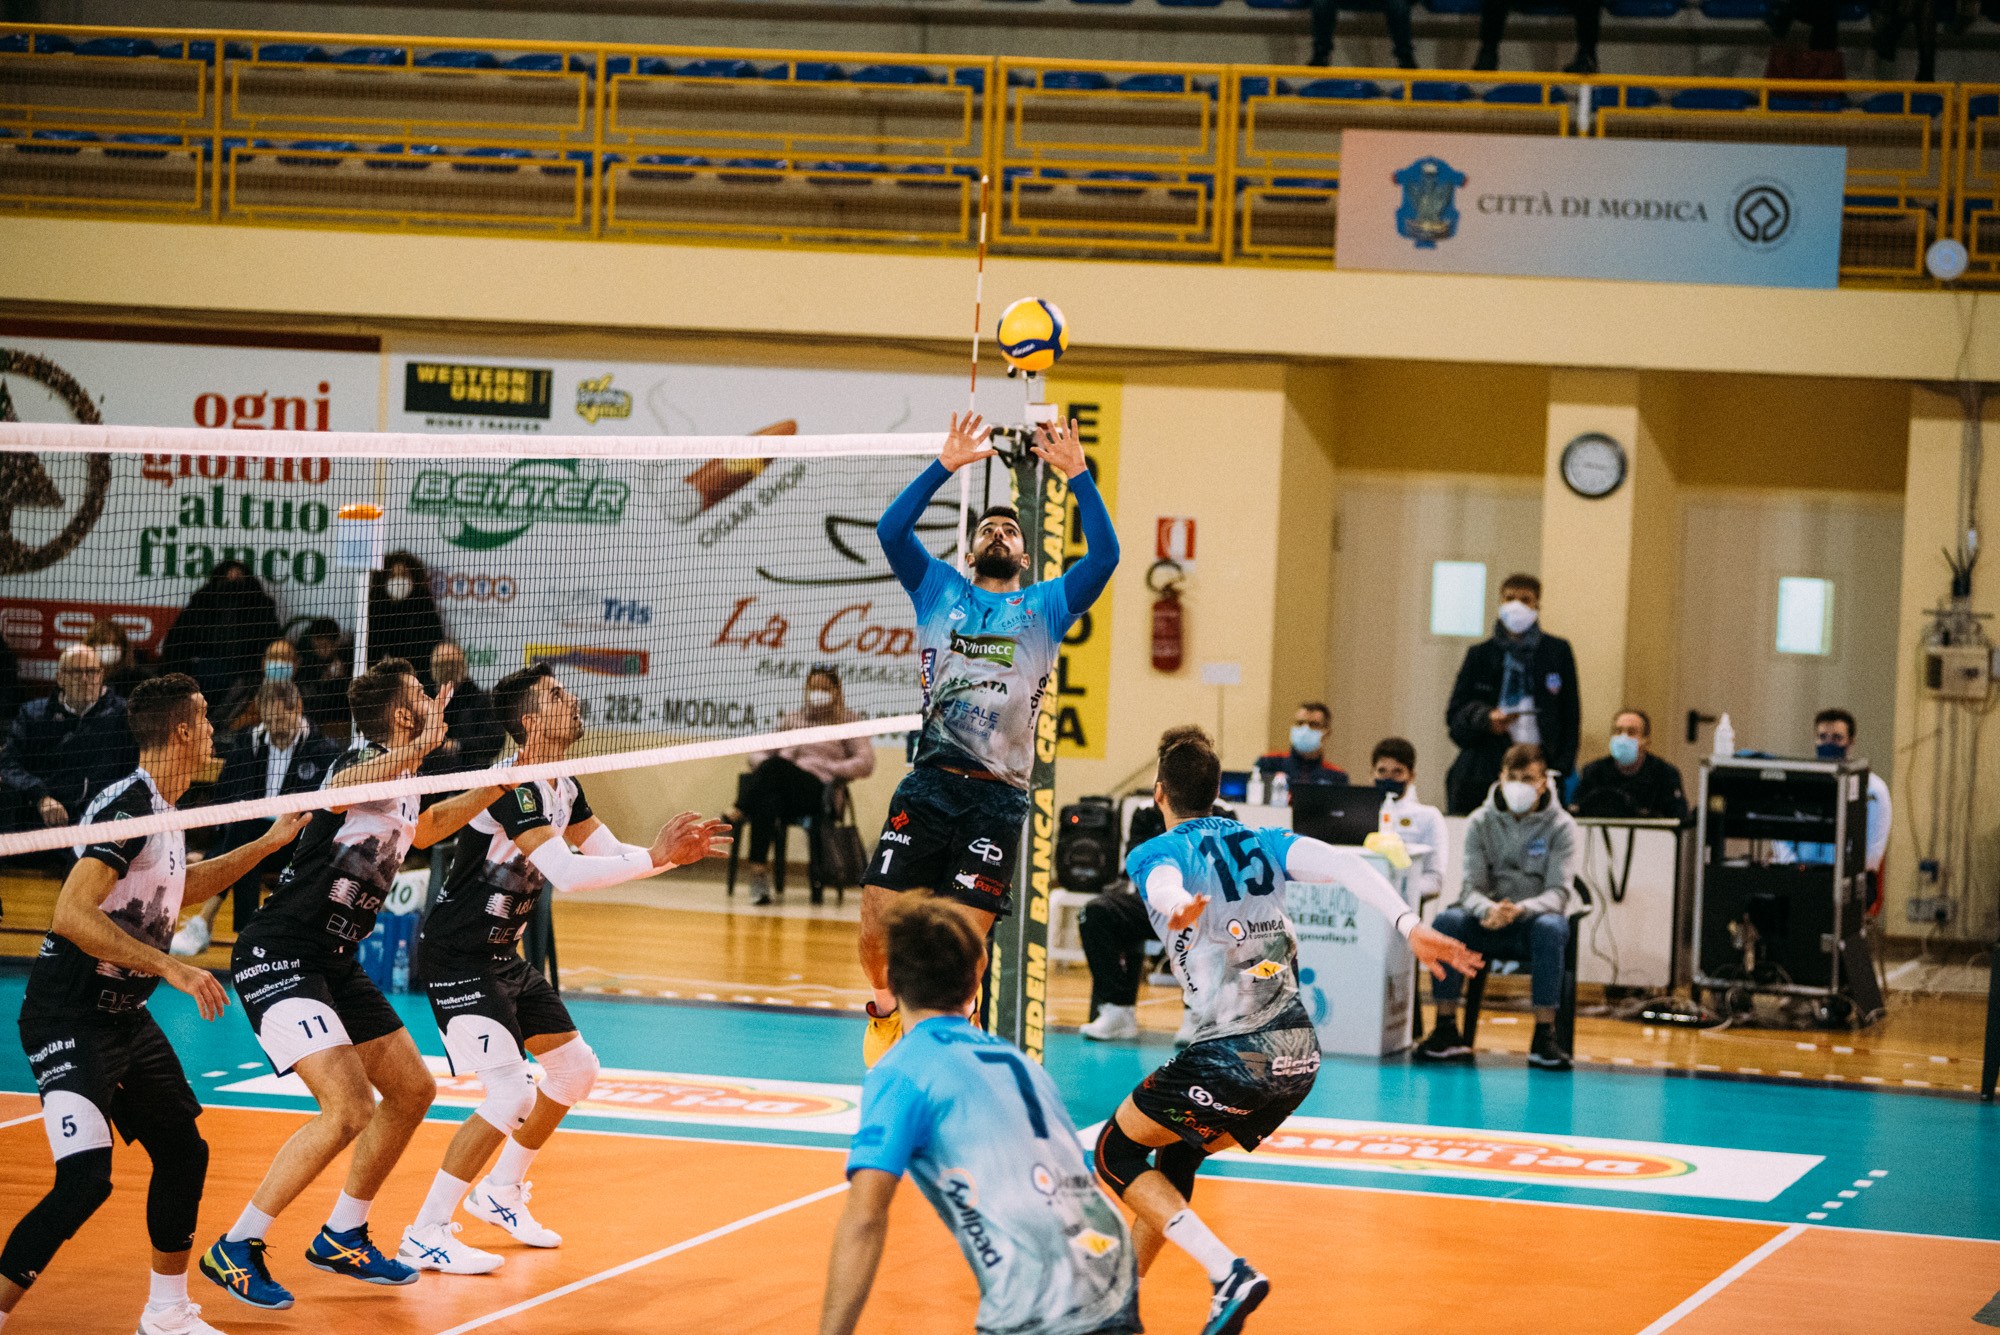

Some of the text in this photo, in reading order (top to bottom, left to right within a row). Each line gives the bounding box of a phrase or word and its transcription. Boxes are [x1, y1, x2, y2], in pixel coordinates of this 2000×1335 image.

[1476, 190, 1709, 223] CITTÀ DI MODICA
[417, 365, 528, 386] WESTERN
[450, 382, 526, 403] UNION
[194, 381, 332, 432] ogni
[179, 484, 329, 535] al tuo
[136, 525, 327, 586] fianco
[603, 598, 650, 625] Tris
[714, 597, 920, 658] La Con
[663, 698, 758, 729] MODICA
[952, 711, 996, 731] UTUA
[955, 699, 1001, 723] REALE
[880, 849, 894, 874] 1
[1030, 788, 1054, 925] BANCA
[1198, 829, 1276, 903] 15
[1343, 916, 1357, 929] A
[271, 960, 290, 971] CAR
[290, 959, 301, 969] srl
[1024, 942, 1047, 1066] REDEM
[298, 1015, 329, 1039] 11
[64, 1038, 76, 1050] srl
[478, 1034, 490, 1054] 7
[973, 1051, 1050, 1140] 7
[61, 1114, 78, 1138] 5
[1262, 1134, 1495, 1163] Mont
[1508, 1152, 1646, 1174] Del
